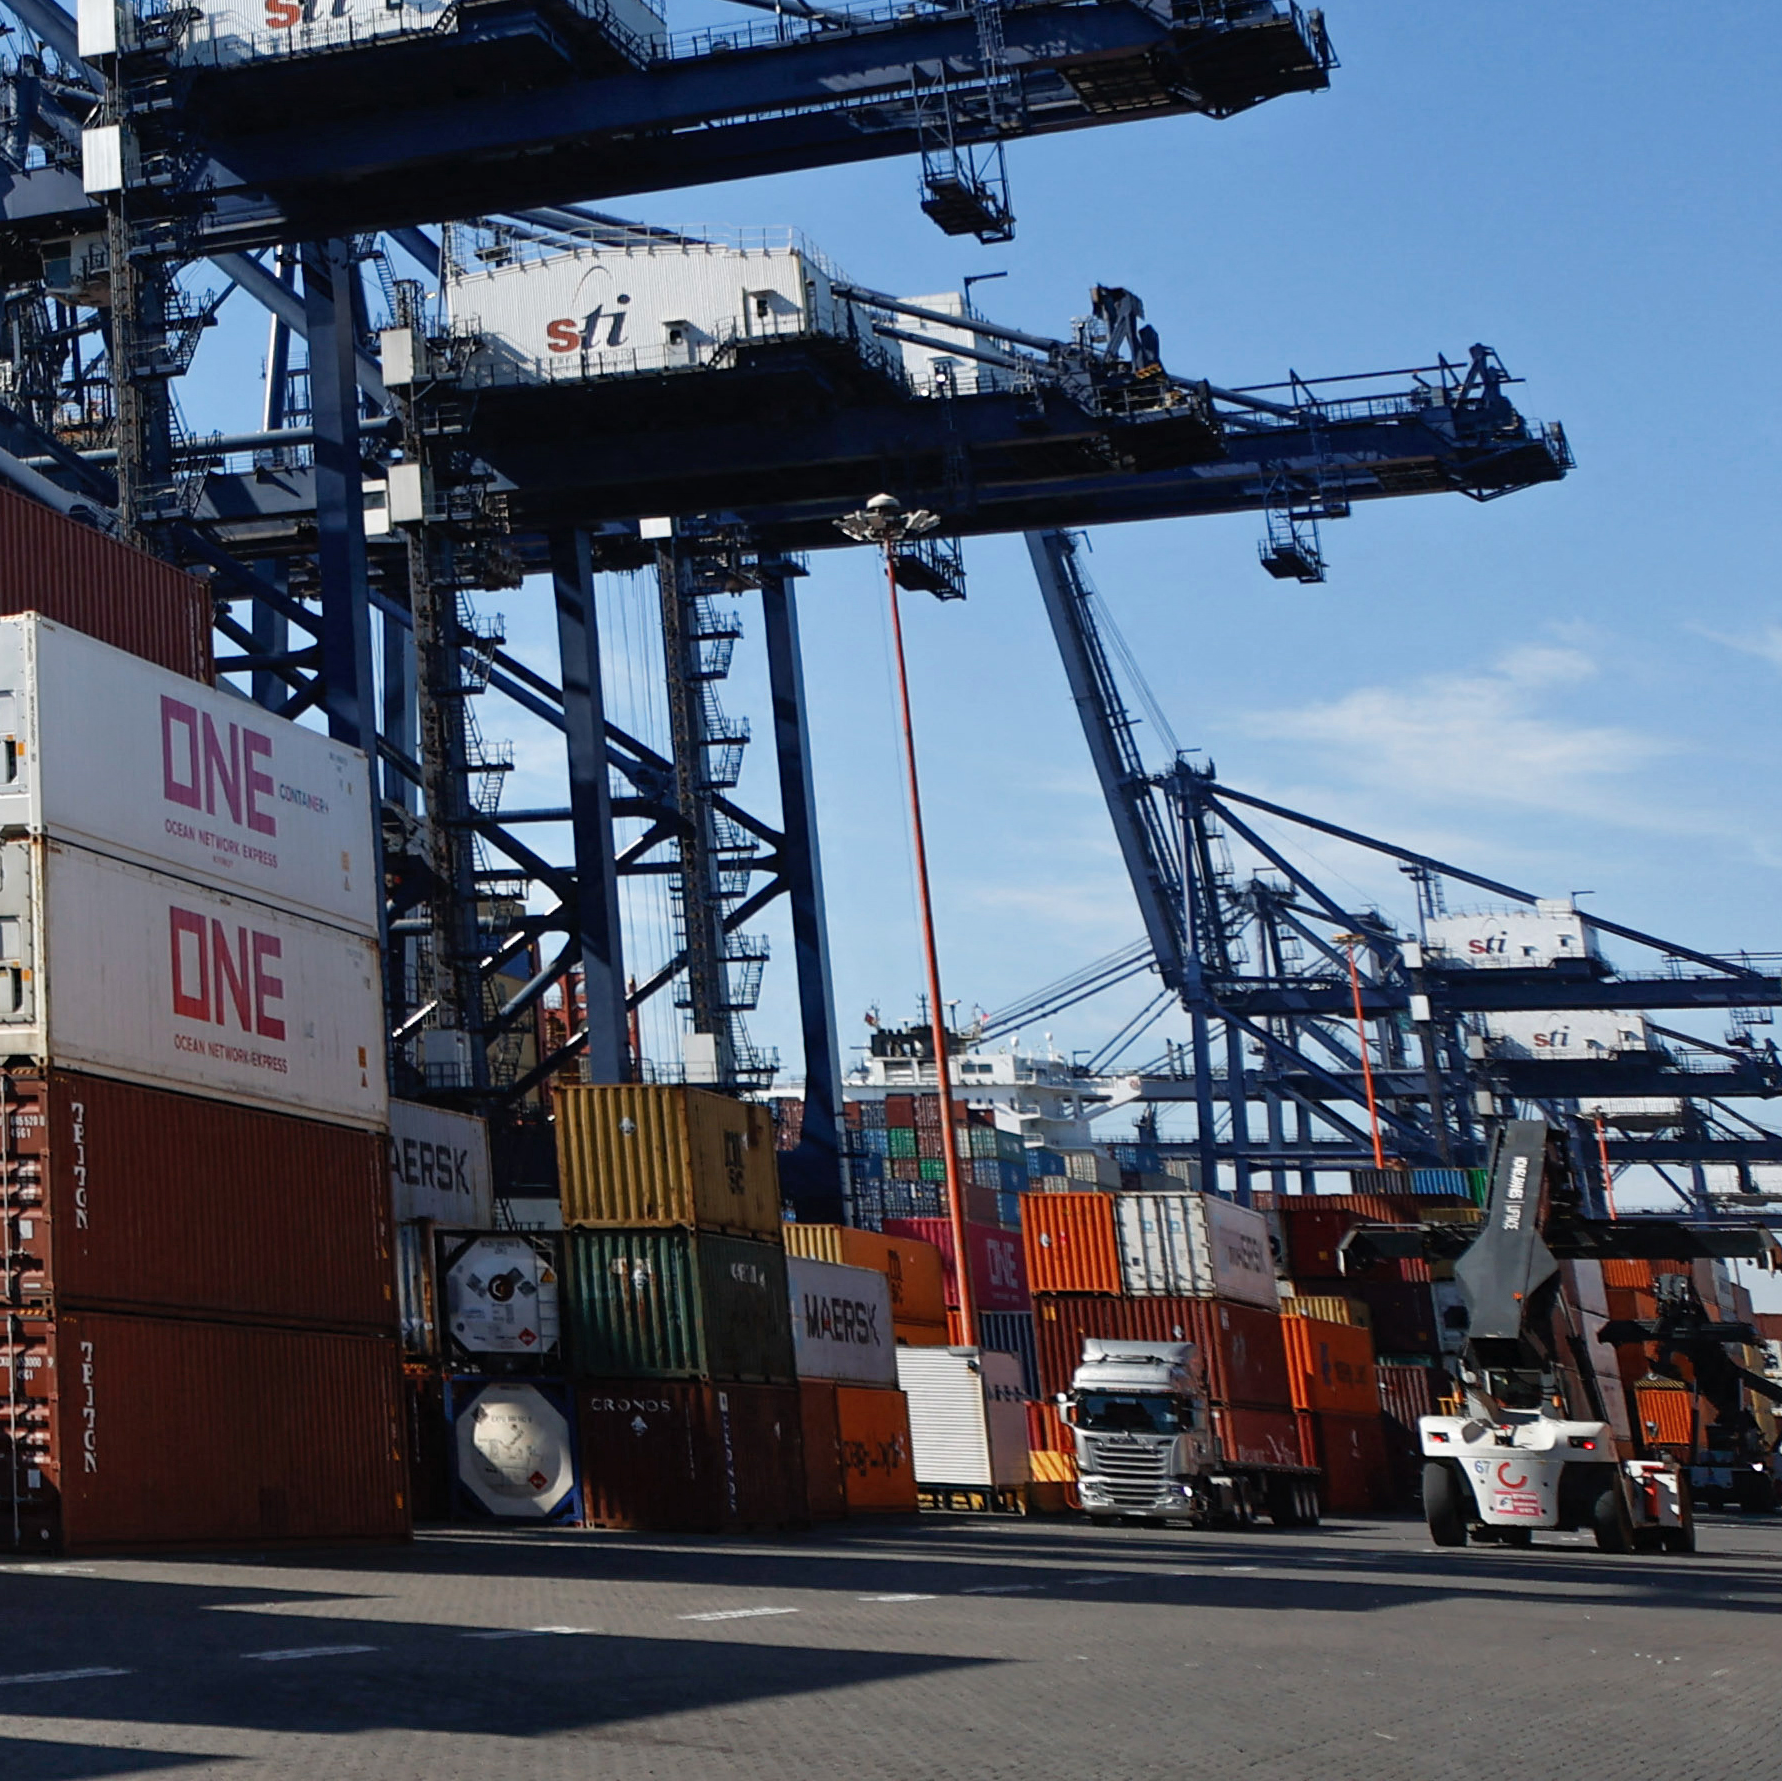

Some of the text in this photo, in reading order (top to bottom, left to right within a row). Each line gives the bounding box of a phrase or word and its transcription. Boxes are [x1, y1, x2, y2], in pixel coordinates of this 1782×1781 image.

[547, 294, 630, 352] sti
[161, 694, 276, 837] ONE
[165, 819, 195, 841] OCEAN
[199, 831, 239, 854] NETWORK
[243, 845, 278, 868] EXPRESS
[1469, 931, 1508, 954] sti
[170, 905, 285, 1041] ONE
[174, 1034, 288, 1074] OCEAN NETWORK EXPRESS
[1534, 1025, 1569, 1047] sti
[71, 1102, 88, 1229] TRITON
[389, 1136, 470, 1195] AERSK
[804, 1293, 881, 1347] MAERSK
[80, 1341, 97, 1473] TRITON
[591, 1397, 672, 1413] CRONOS
[1475, 1460, 1490, 1473] 67
